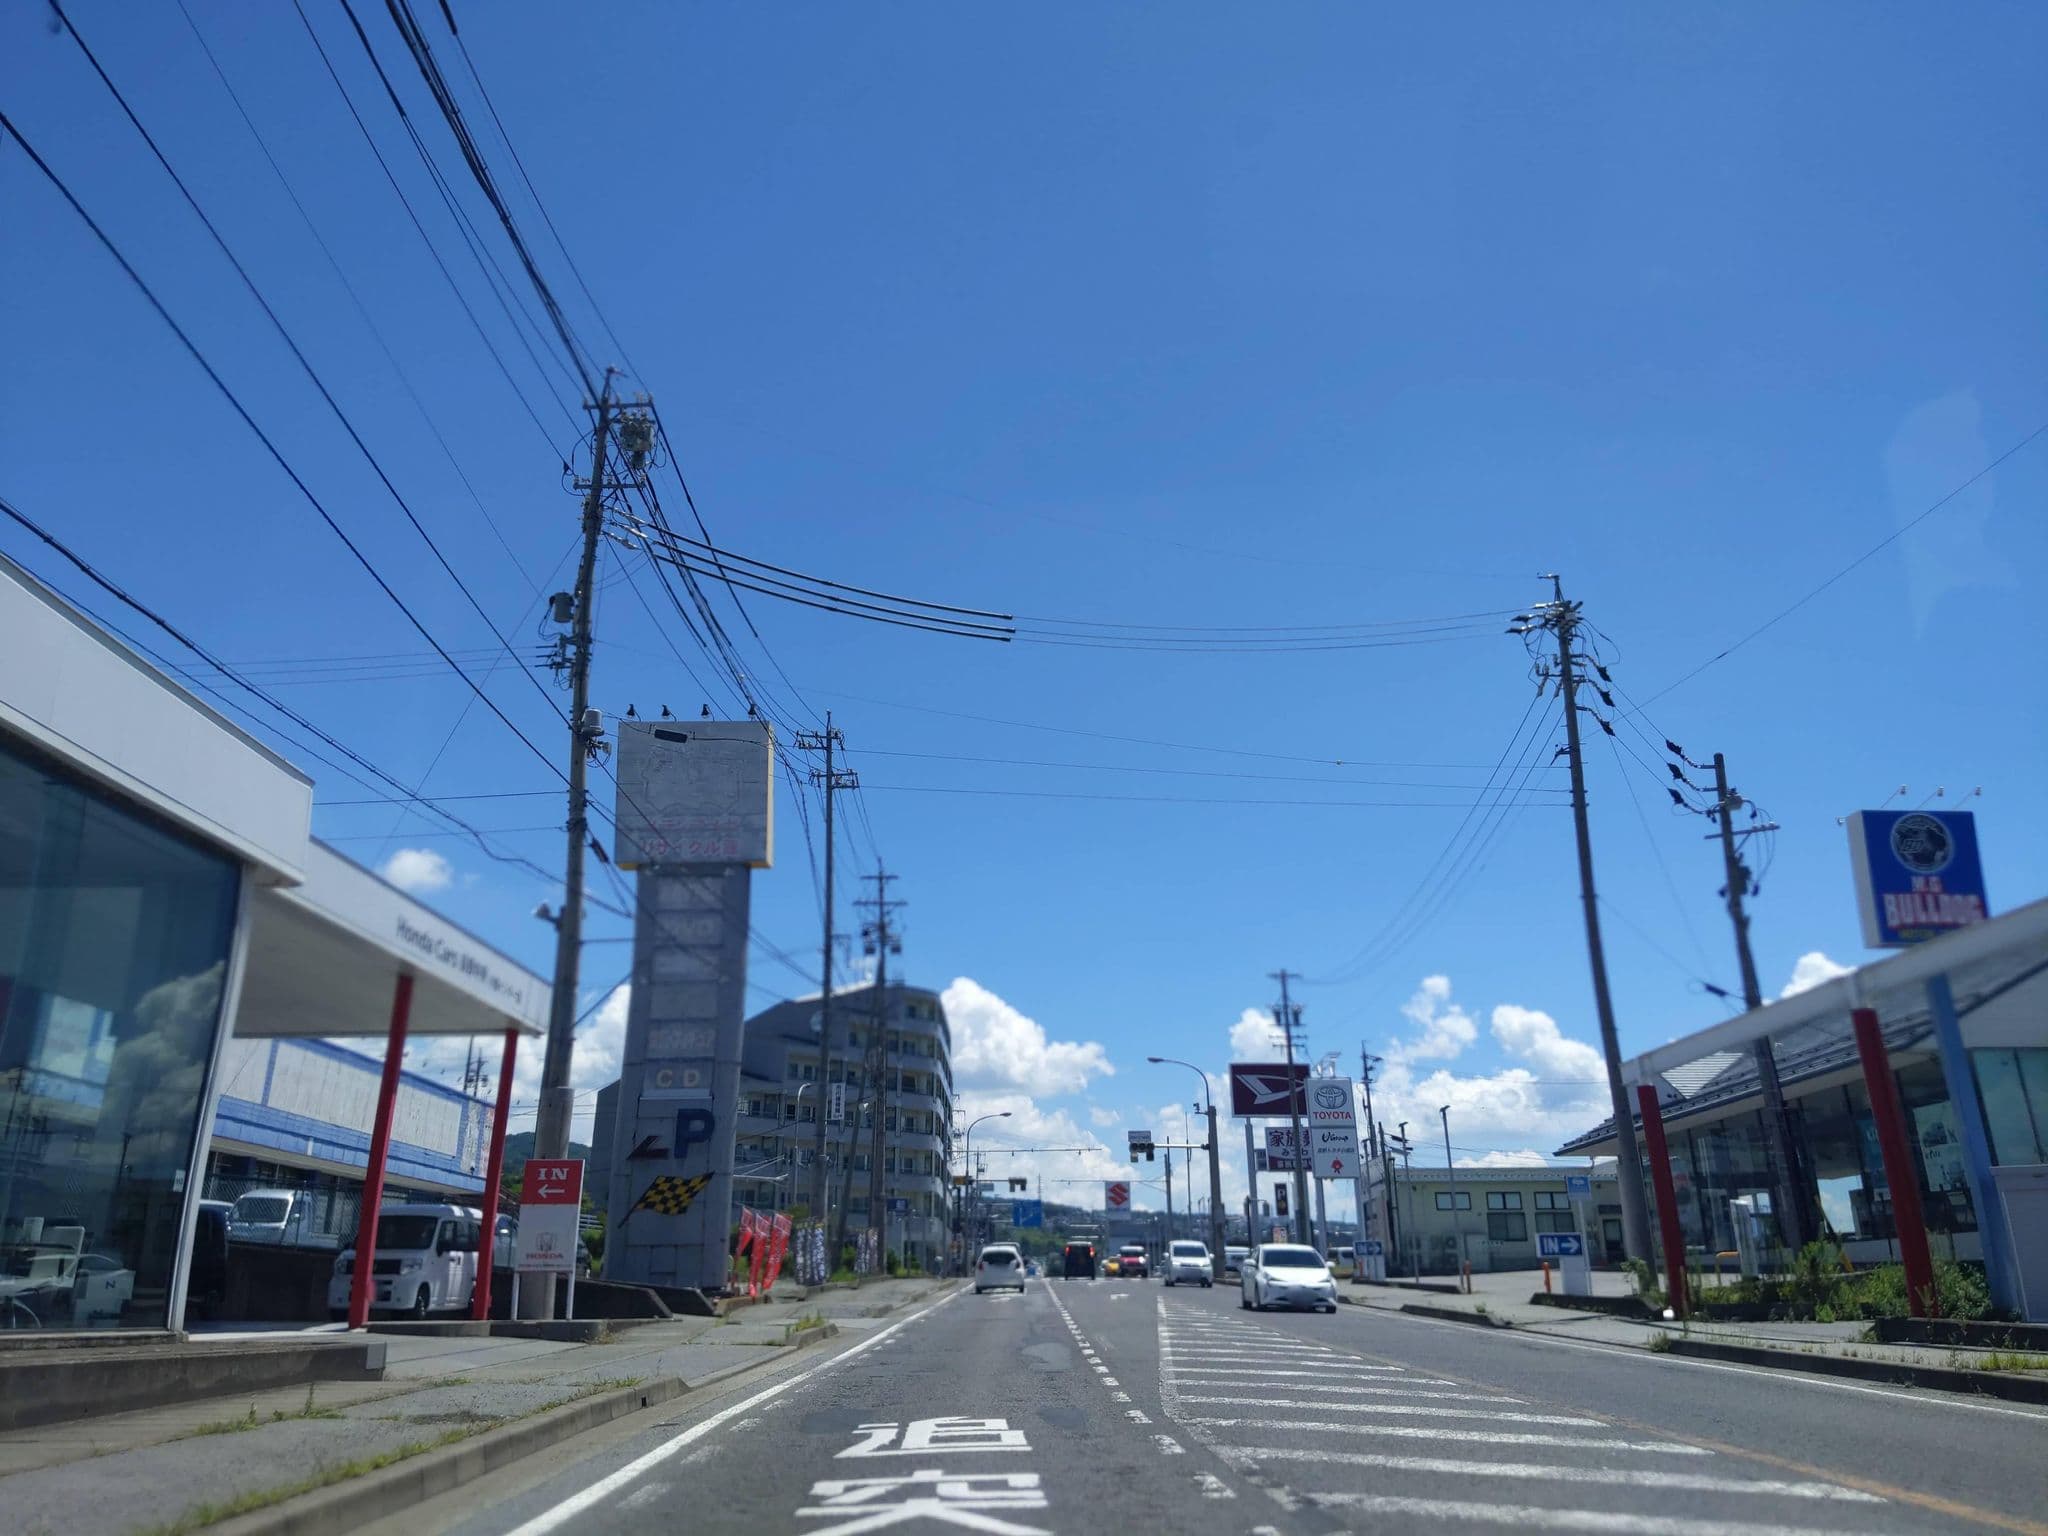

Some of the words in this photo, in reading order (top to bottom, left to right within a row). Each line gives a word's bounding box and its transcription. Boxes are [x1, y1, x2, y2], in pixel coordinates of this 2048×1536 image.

[1884, 893, 1985, 928] BULLDOG
[397, 915, 432, 953] Honda
[434, 939, 458, 968] Cars
[1313, 1111, 1352, 1119] TOYOTA
[674, 1108, 715, 1159] P
[537, 1168, 569, 1180] IN
[1543, 1237, 1559, 1254] IN
